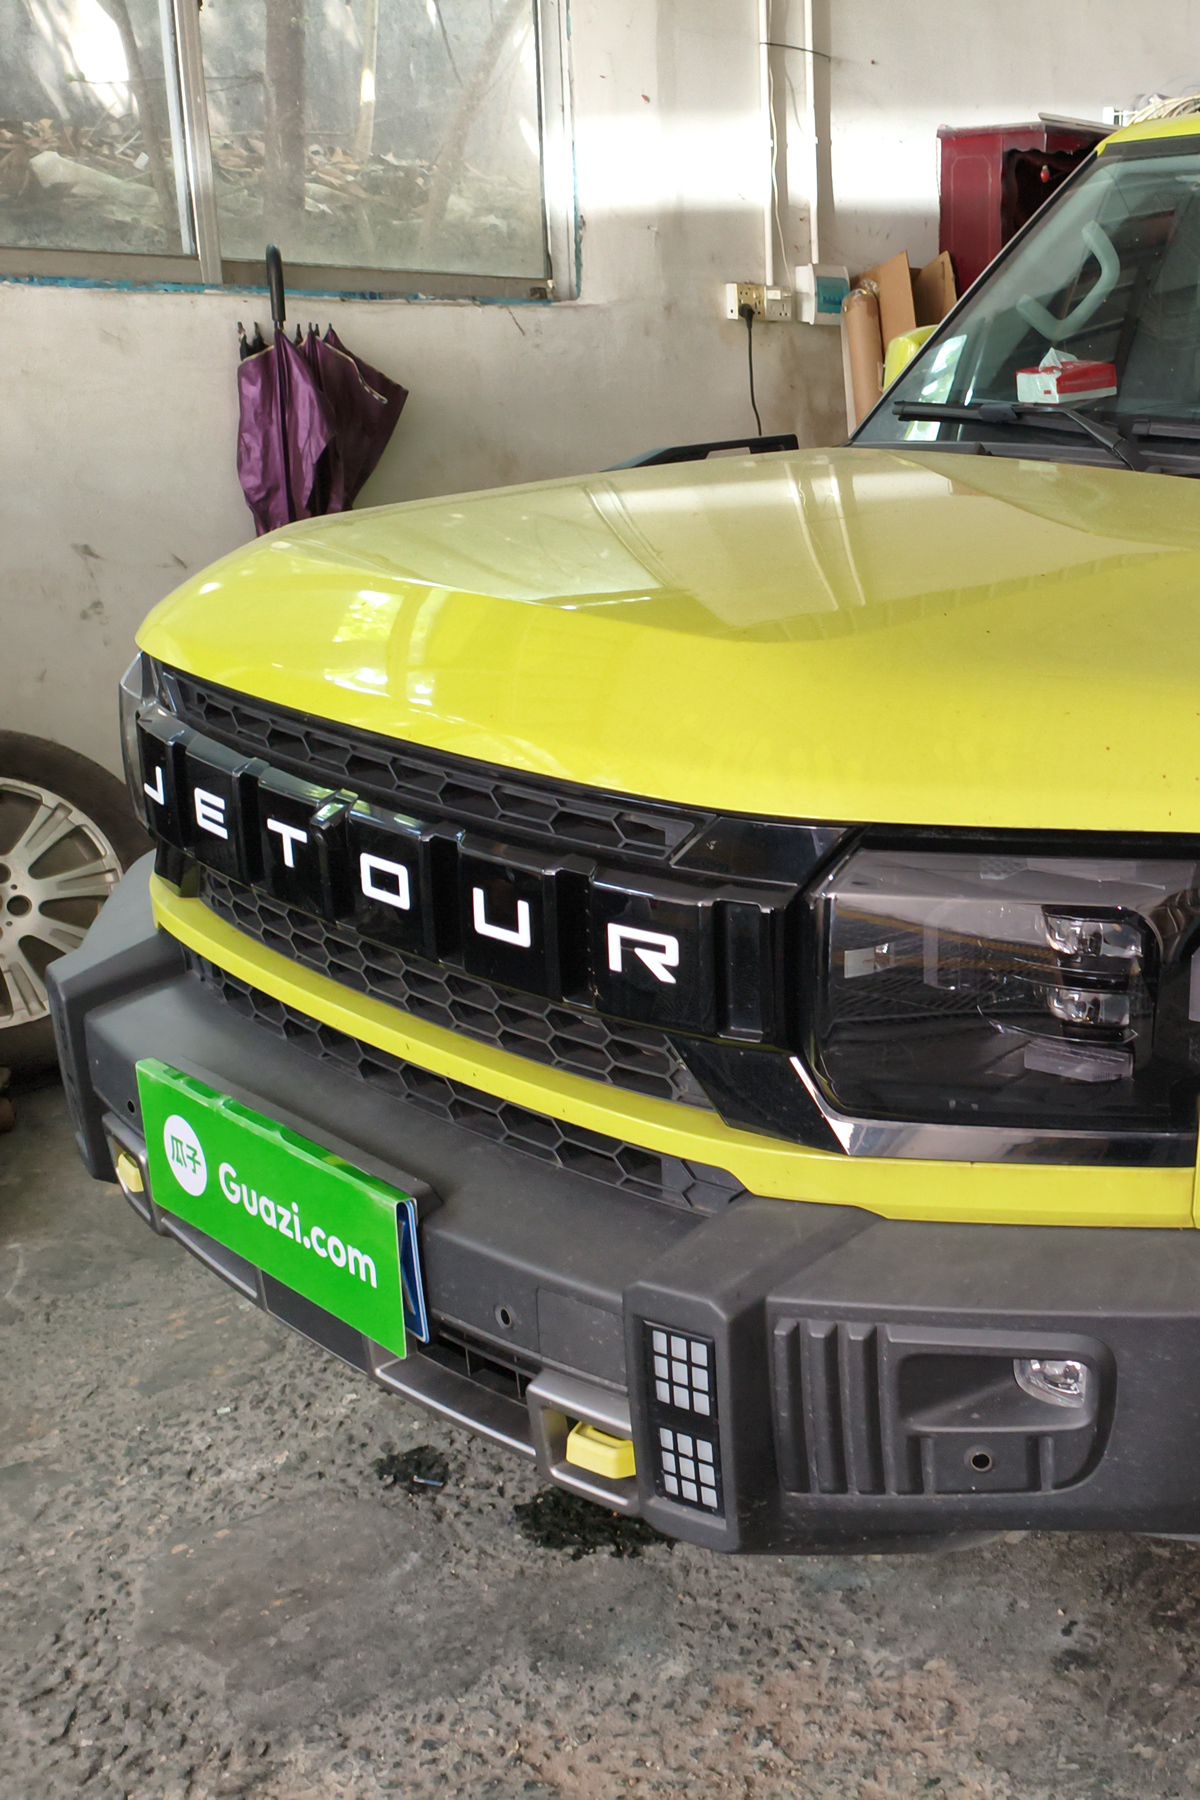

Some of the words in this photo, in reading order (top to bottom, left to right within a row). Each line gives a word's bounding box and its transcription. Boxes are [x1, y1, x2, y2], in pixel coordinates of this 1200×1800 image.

[143, 765, 680, 984] JETOUR
[169, 1134, 202, 1175] 瓜子
[218, 1161, 378, 1289] Guazi.com
